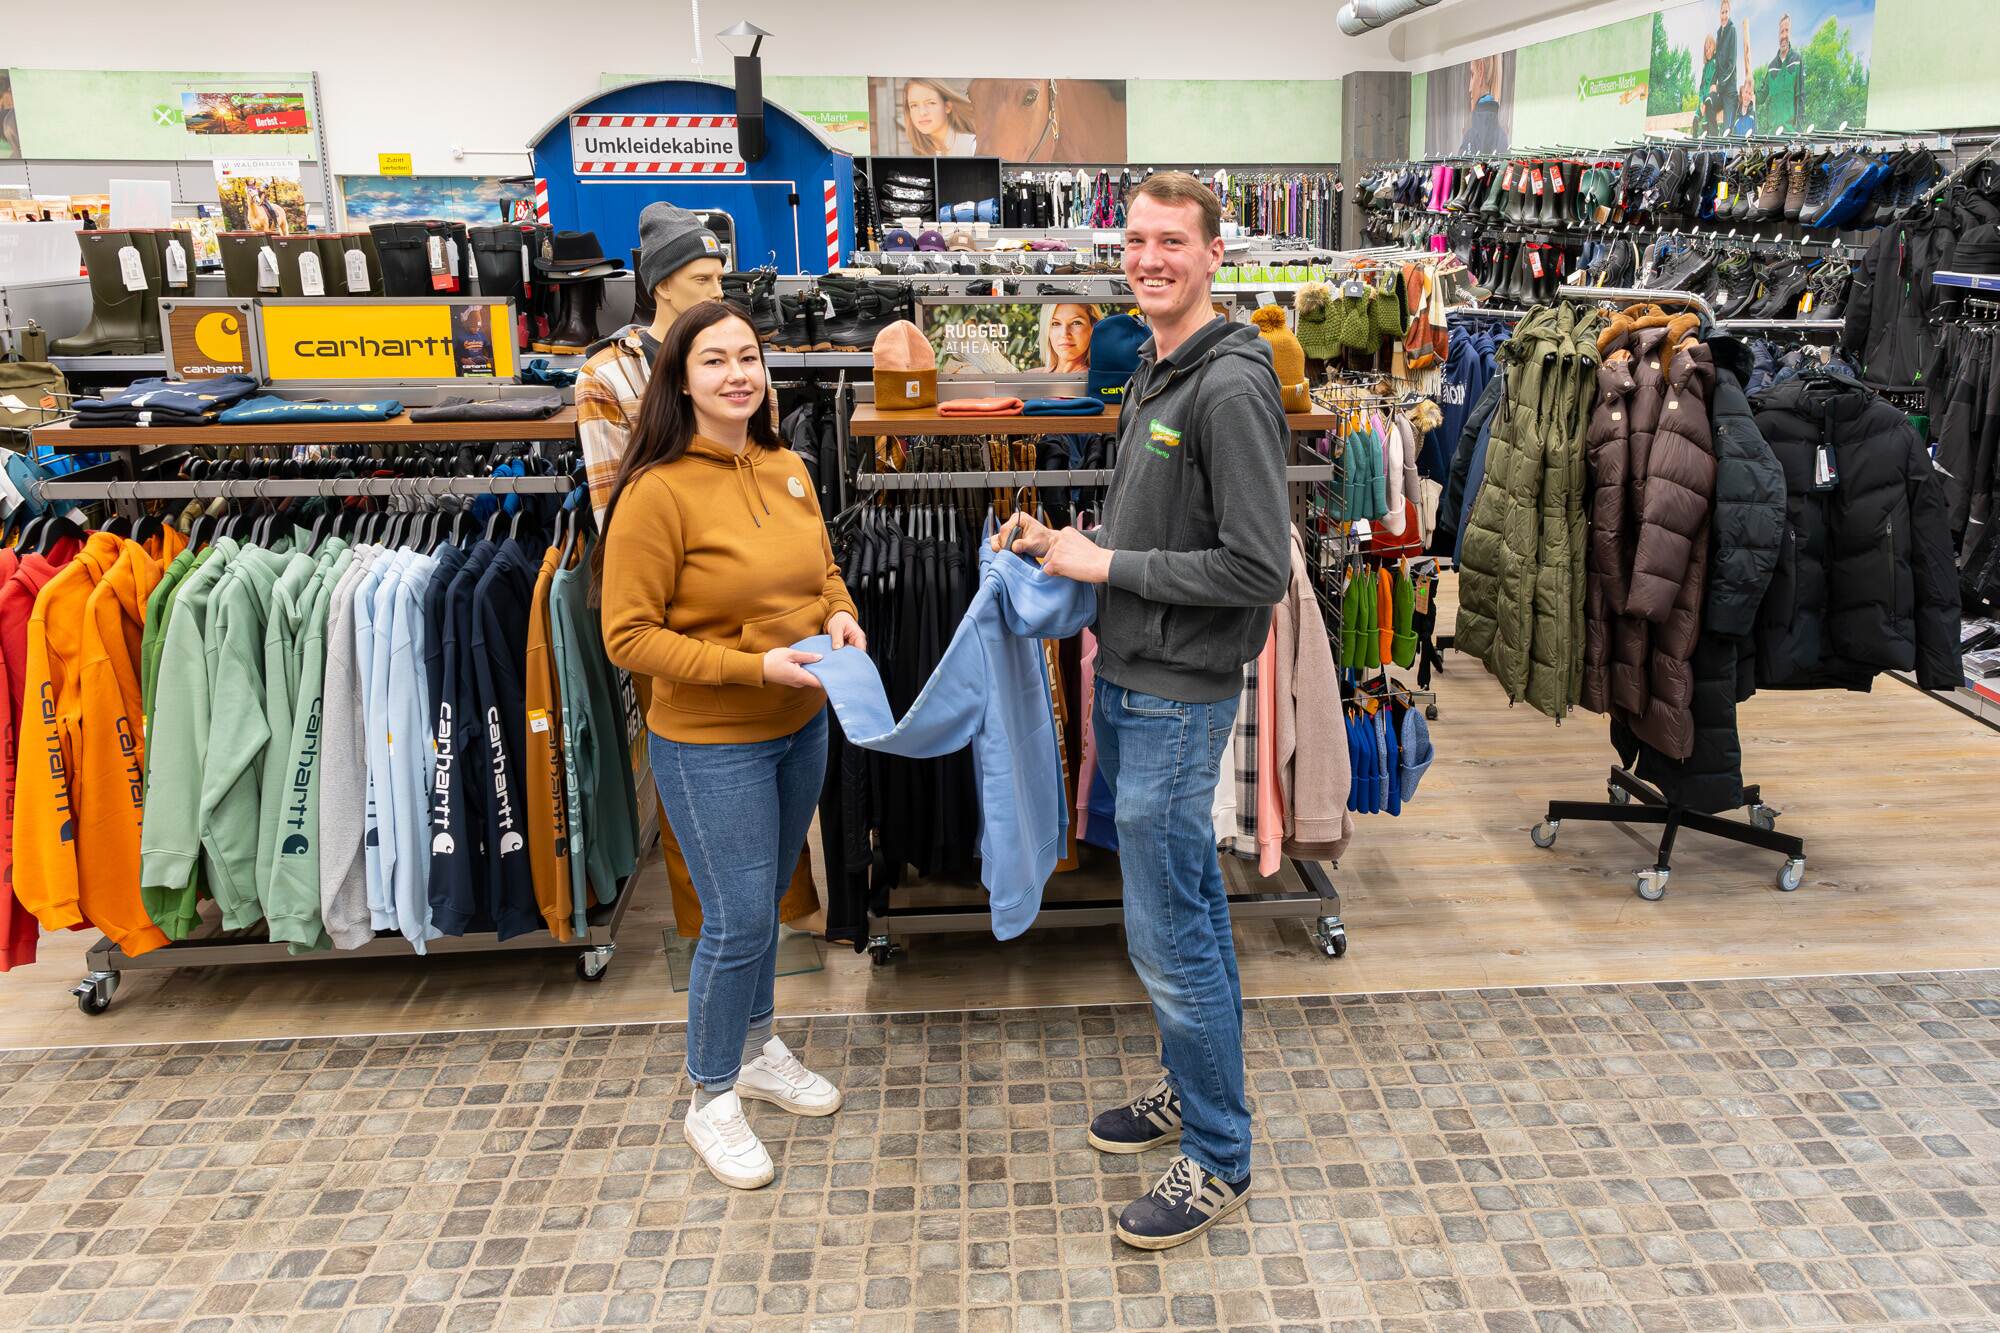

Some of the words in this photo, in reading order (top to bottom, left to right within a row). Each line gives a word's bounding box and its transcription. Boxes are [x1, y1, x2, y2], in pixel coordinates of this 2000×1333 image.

[255, 116, 279, 127] Herbst
[806, 112, 848, 122] n-Markt
[584, 137, 733, 154] Umkleidekabine
[233, 160, 294, 168] WALDHAUSEN
[945, 323, 1009, 339] RUGGED
[294, 336, 453, 357] carhartt
[946, 341, 958, 354] AT
[960, 340, 1010, 354] HEART
[182, 364, 245, 374] carhartt
[286, 696, 322, 830] carhartt
[434, 701, 454, 830] carhartt
[487, 705, 514, 830] carhartt
